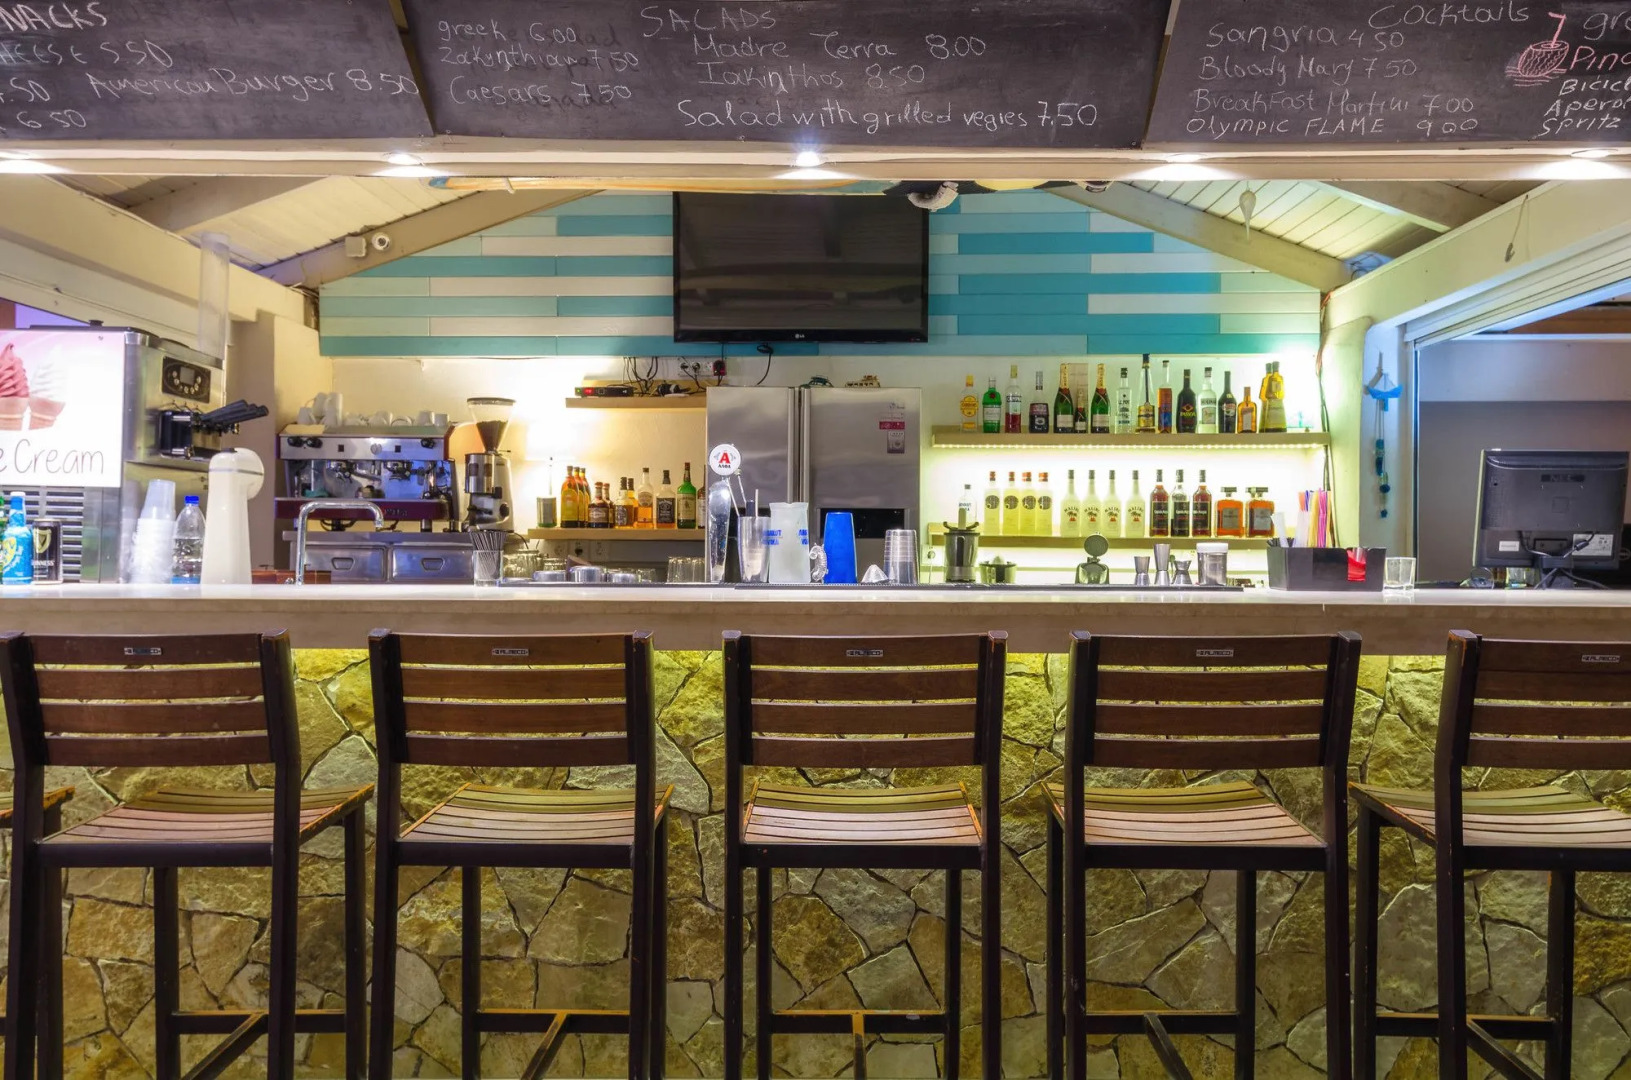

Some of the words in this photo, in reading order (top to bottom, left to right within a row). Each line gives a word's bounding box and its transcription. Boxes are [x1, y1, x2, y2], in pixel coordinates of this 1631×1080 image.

[694, 34, 790, 58] Madre
[1199, 54, 1286, 86] Bloody
[1297, 54, 1353, 86] Mary
[678, 99, 781, 127] Salad
[792, 99, 857, 127] with
[864, 101, 951, 135] grilled
[963, 110, 1028, 131] vegies
[1305, 116, 1385, 137] FLAME
[14, 438, 104, 475] Cream
